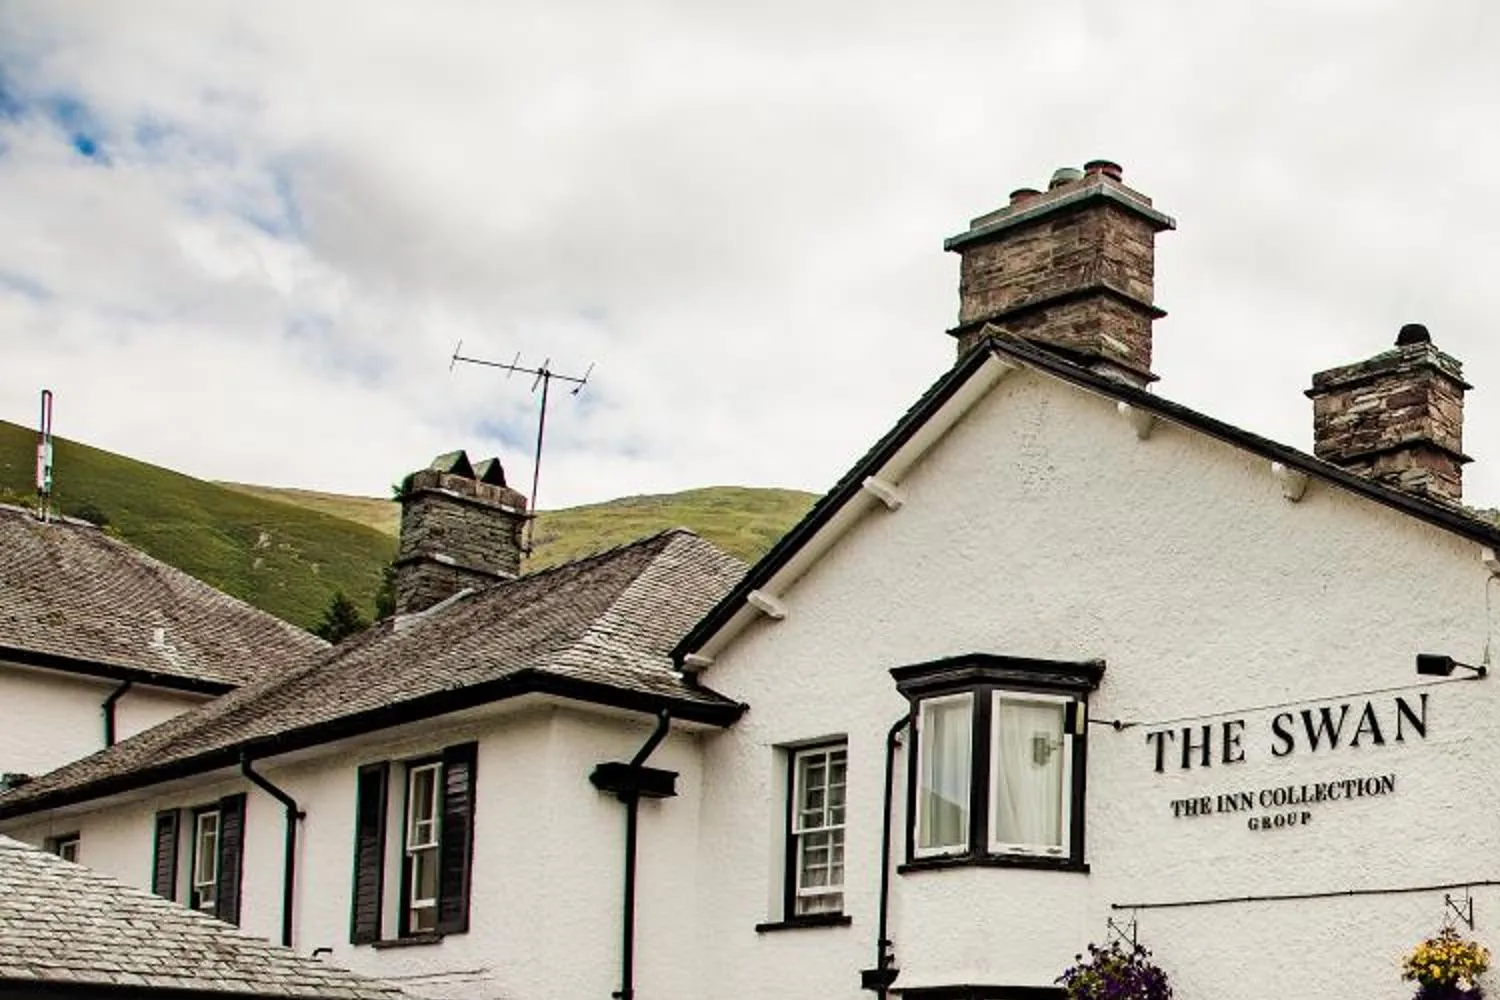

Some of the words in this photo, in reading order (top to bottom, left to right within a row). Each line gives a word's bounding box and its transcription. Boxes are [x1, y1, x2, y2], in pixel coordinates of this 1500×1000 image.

[1146, 718, 1246, 774] THE
[1270, 692, 1430, 757] SWAN
[1169, 795, 1212, 819] THE
[1216, 791, 1255, 813] INN
[1258, 773, 1398, 808] COLLECTION
[1247, 811, 1313, 831] GROUP
